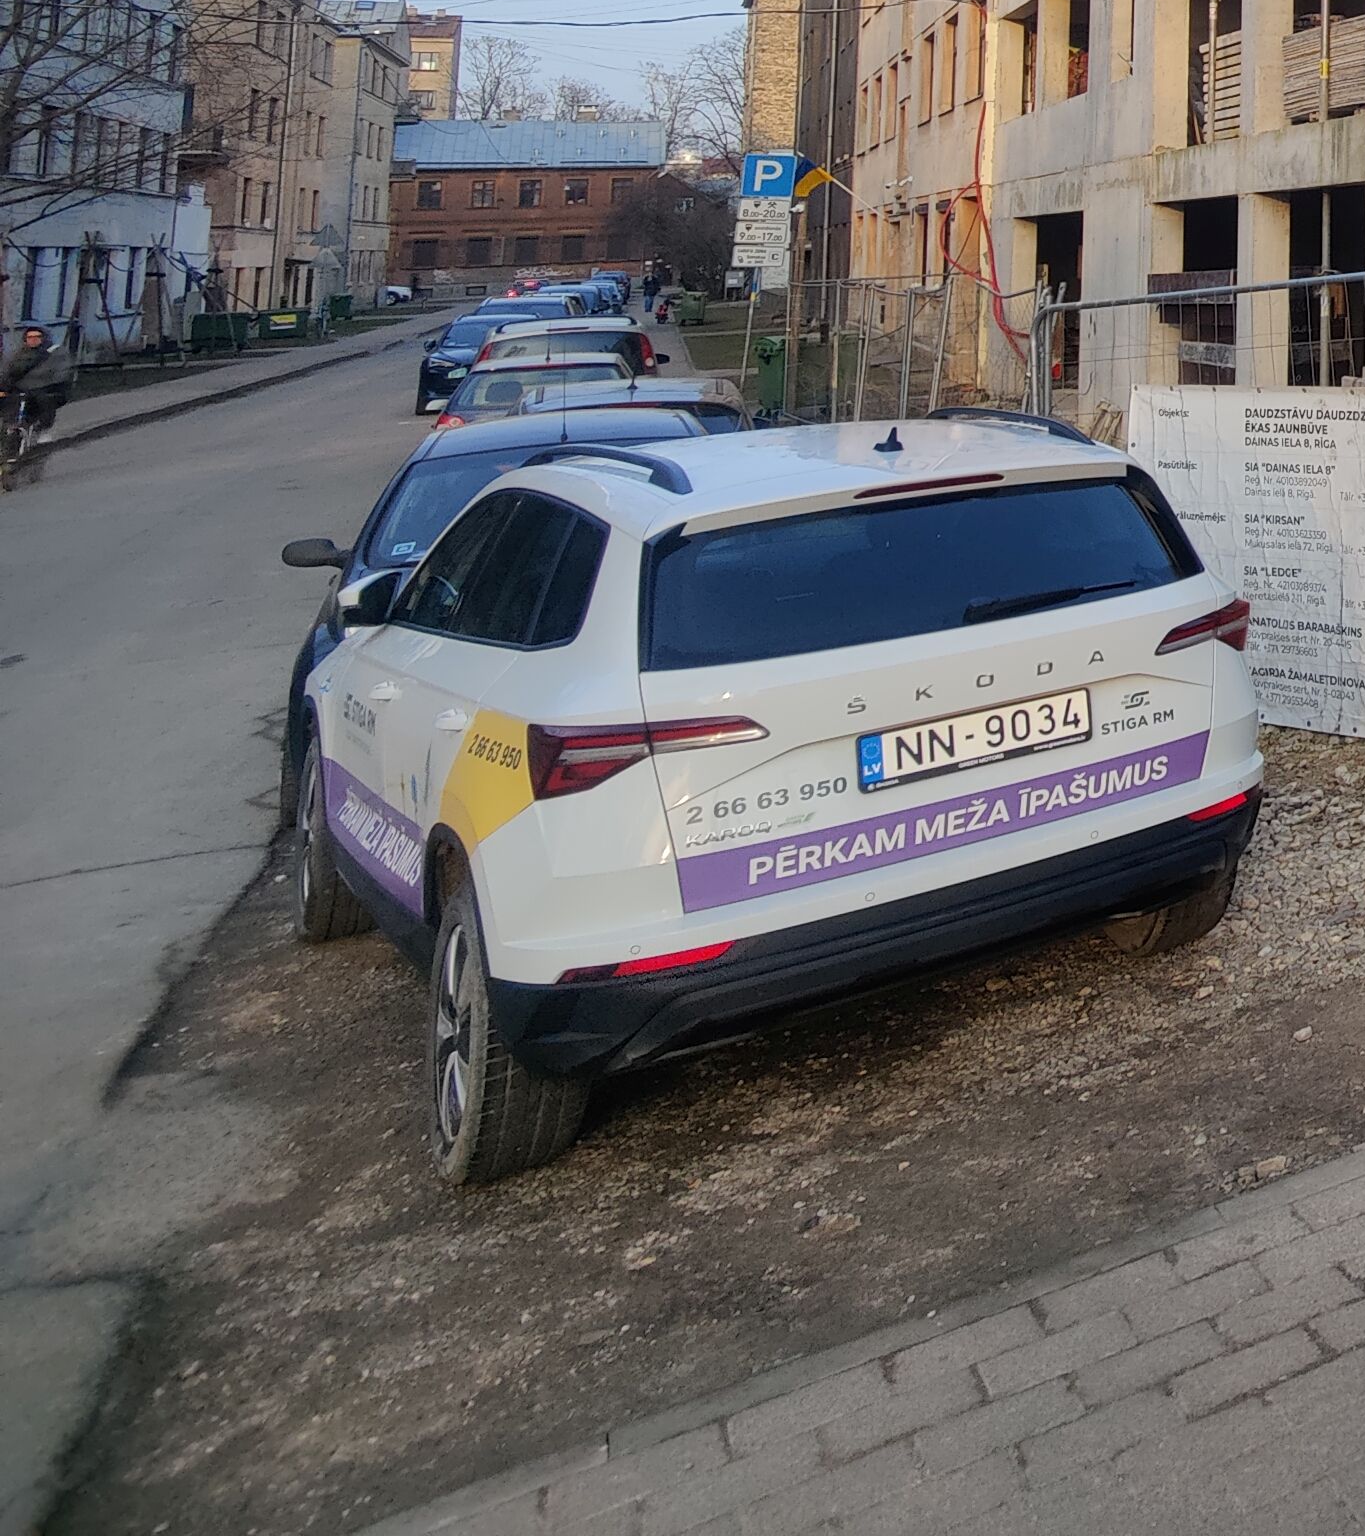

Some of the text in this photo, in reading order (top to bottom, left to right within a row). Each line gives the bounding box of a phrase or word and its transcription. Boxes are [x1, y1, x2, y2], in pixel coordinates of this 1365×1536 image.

[753, 159, 784, 192] P
[771, 253, 780, 261] C
[1245, 406, 1314, 420] DAUDZSTĀVU
[1244, 420, 1329, 436] ĒKAS JAUNBŪVE
[1244, 437, 1280, 448] DAINAS
[1281, 438, 1301, 449] IELA
[1314, 437, 1337, 450] RĪGA
[1244, 462, 1259, 472] SIA
[1302, 464, 1324, 475] IELA
[1244, 513, 1260, 524] SIA
[1243, 565, 1258, 577] SIA
[1297, 620, 1363, 639] BARABAŠKINS
[846, 649, 1105, 715] ŠKODA
[1101, 708, 1175, 736] STIGA RM
[895, 697, 1081, 771] NN-9034
[467, 733, 522, 770] 2 66 63 950
[863, 762, 882, 776] LV
[686, 776, 848, 825] 2 66 63 950
[746, 755, 1170, 886] PĒRKAM MEŽA ĪPAŠUMUS
[685, 820, 773, 848] KAROQ
